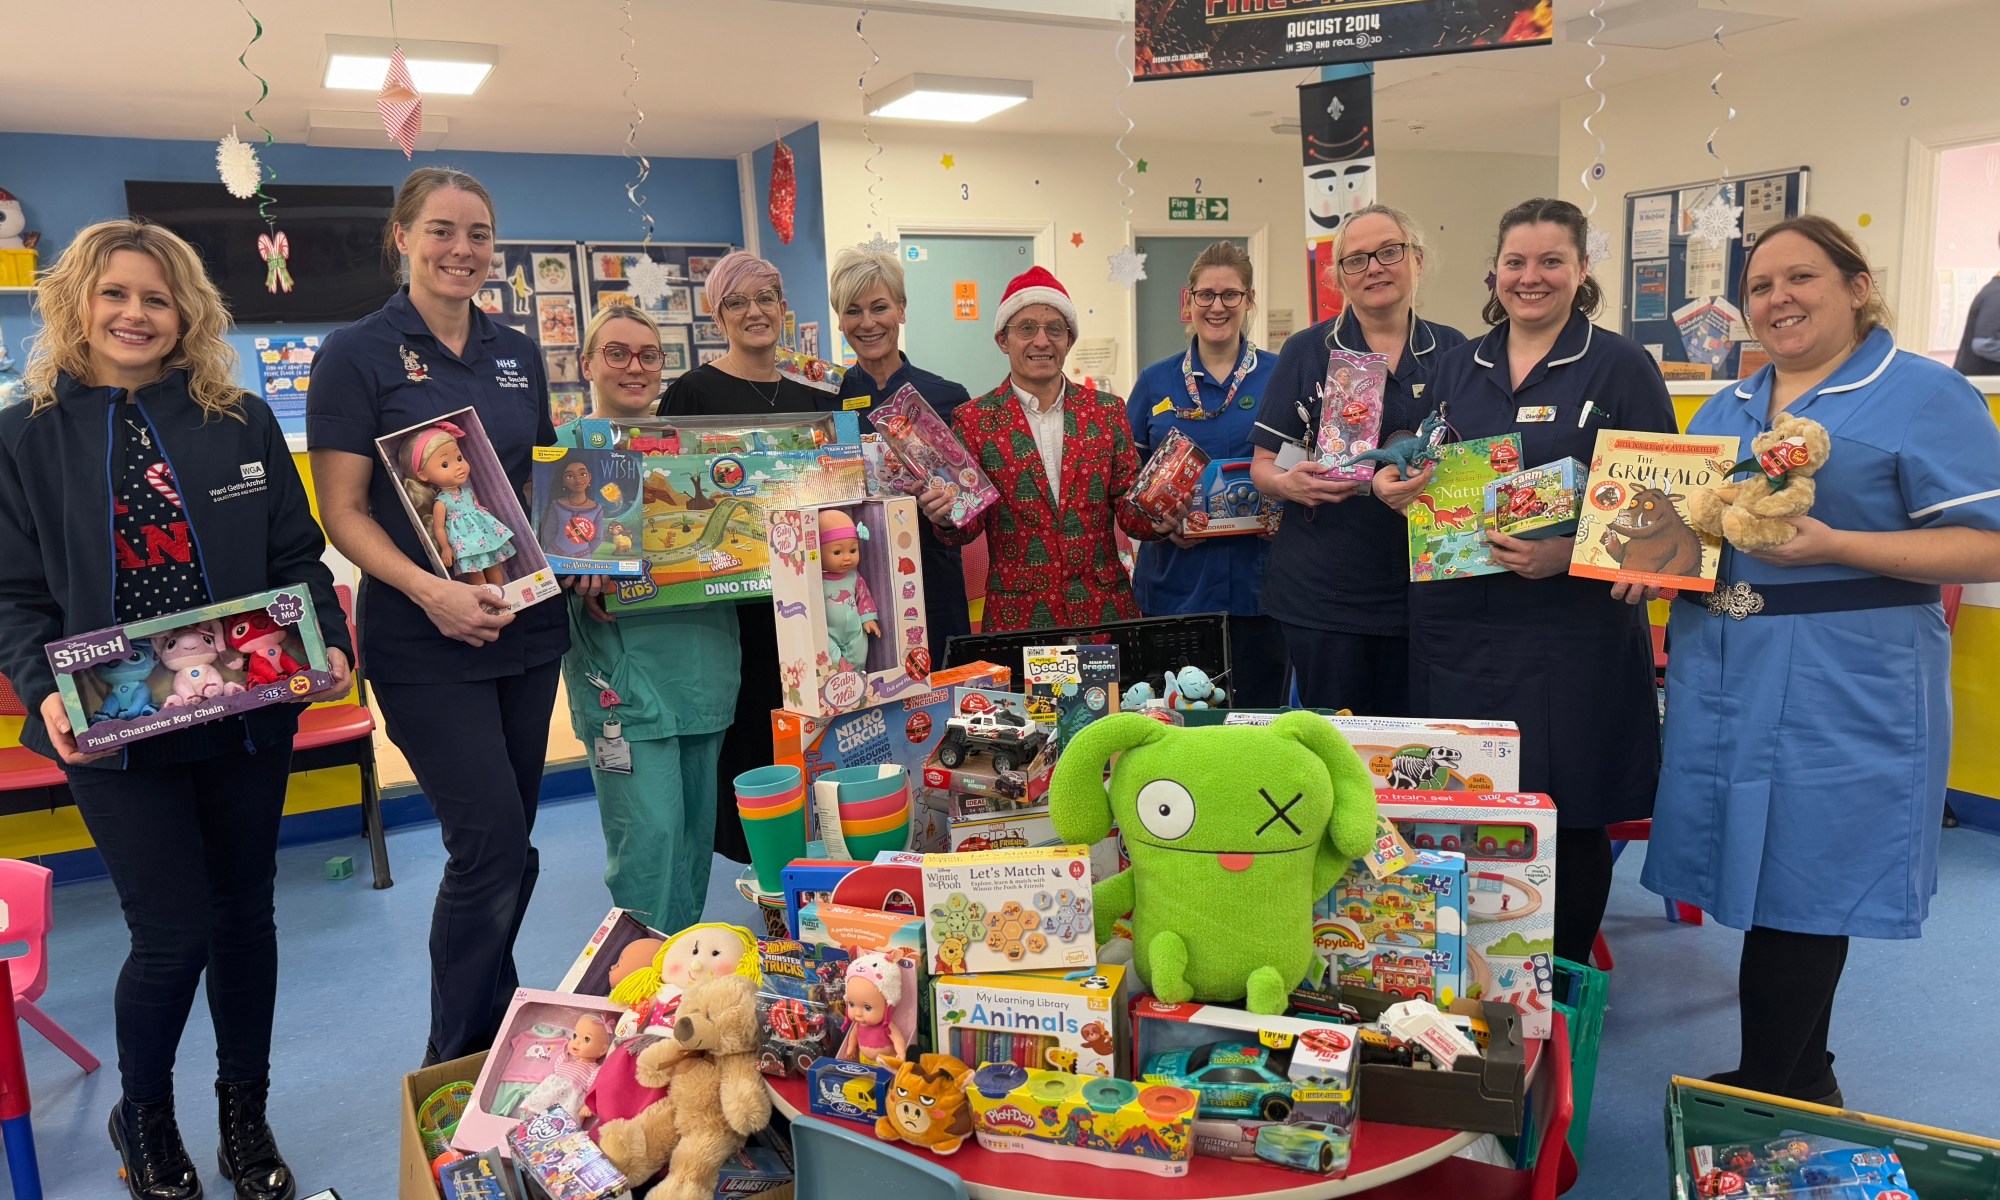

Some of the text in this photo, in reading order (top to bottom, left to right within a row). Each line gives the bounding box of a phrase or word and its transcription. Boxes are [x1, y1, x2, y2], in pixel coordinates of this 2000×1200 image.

[1287, 13, 1380, 39] AUGUST 2014
[1286, 35, 1382, 53] IN 3D AND 3D
[1152, 52, 1209, 64] DISNEY.CO.UK/PLANES
[961, 183, 969, 200] 3
[1195, 178, 1202, 194] 2
[1171, 199, 1188, 208] Fire
[1172, 209, 1188, 218] exit
[962, 284, 968, 294] 3
[1679, 314, 1704, 330] Diabetes
[496, 359, 517, 368] NHS
[1615, 440, 1719, 454] JULIA DONALDSON AXEL SCHEFFLER
[1637, 454, 1654, 464] THE
[242, 466, 262, 475] WGA
[600, 459, 636, 479] WISH
[1608, 462, 1710, 486] GRUFFALO
[209, 478, 267, 497] Ward Gethin Archer
[804, 515, 815, 525] 2+
[775, 525, 792, 542] Baby
[778, 538, 792, 551] Mia
[710, 559, 742, 572] WORLD!
[713, 555, 732, 565] DINO
[619, 576, 647, 587] LITTLE
[621, 583, 654, 600] KIDS
[705, 581, 740, 596] DINO
[278, 602, 294, 612] Try
[281, 610, 298, 620] Me!
[1029, 660, 1077, 675] beads
[1082, 663, 1116, 672] Dragons
[830, 671, 857, 691] Baby
[886, 685, 896, 693] Doll
[911, 688, 948, 701] CHARACTERS
[833, 689, 857, 704] Mia
[903, 694, 948, 711] 3 INCLUDED
[87, 704, 225, 748] Plush Character Key Chain
[834, 708, 883, 742] NITRO
[838, 719, 887, 753] CIRCUS
[1482, 740, 1493, 748] 20
[842, 737, 889, 764] WORLD FAMOUS
[845, 743, 891, 768] AIRBOUND
[1498, 747, 1512, 758] 3+
[873, 751, 893, 765] TOYS
[1392, 793, 1426, 801] train
[1000, 839, 1029, 848] FRIENDS
[1374, 845, 1405, 865] DOLLS
[926, 873, 959, 882] Winnie
[969, 864, 1046, 880] Let's Match
[938, 880, 962, 890] Pooh
[970, 880, 994, 888] Explore,
[1434, 877, 1441, 886] 6
[607, 911, 617, 921] 2+
[802, 920, 819, 928] PUZZLE
[835, 927, 854, 935] perfect
[854, 928, 886, 939] introduction
[856, 935, 876, 943] games!
[766, 941, 782, 954] HOT
[764, 954, 801, 965] MONSTER
[1065, 952, 1089, 962] shuffle
[1431, 952, 1444, 962] 12
[764, 960, 805, 977] TRUCKS
[516, 990, 527, 998] 24+
[976, 992, 1070, 1010] My Learning Library
[968, 1003, 1079, 1034] Animals
[1264, 1031, 1277, 1039] TRY
[1533, 1025, 1547, 1036] 3+
[841, 1063, 864, 1073] Ford
[836, 1104, 857, 1114] Ford
[985, 1108, 1035, 1129] Play-Doh
[532, 1119, 561, 1138] PONY
[1203, 1144, 1225, 1152] TUNER
